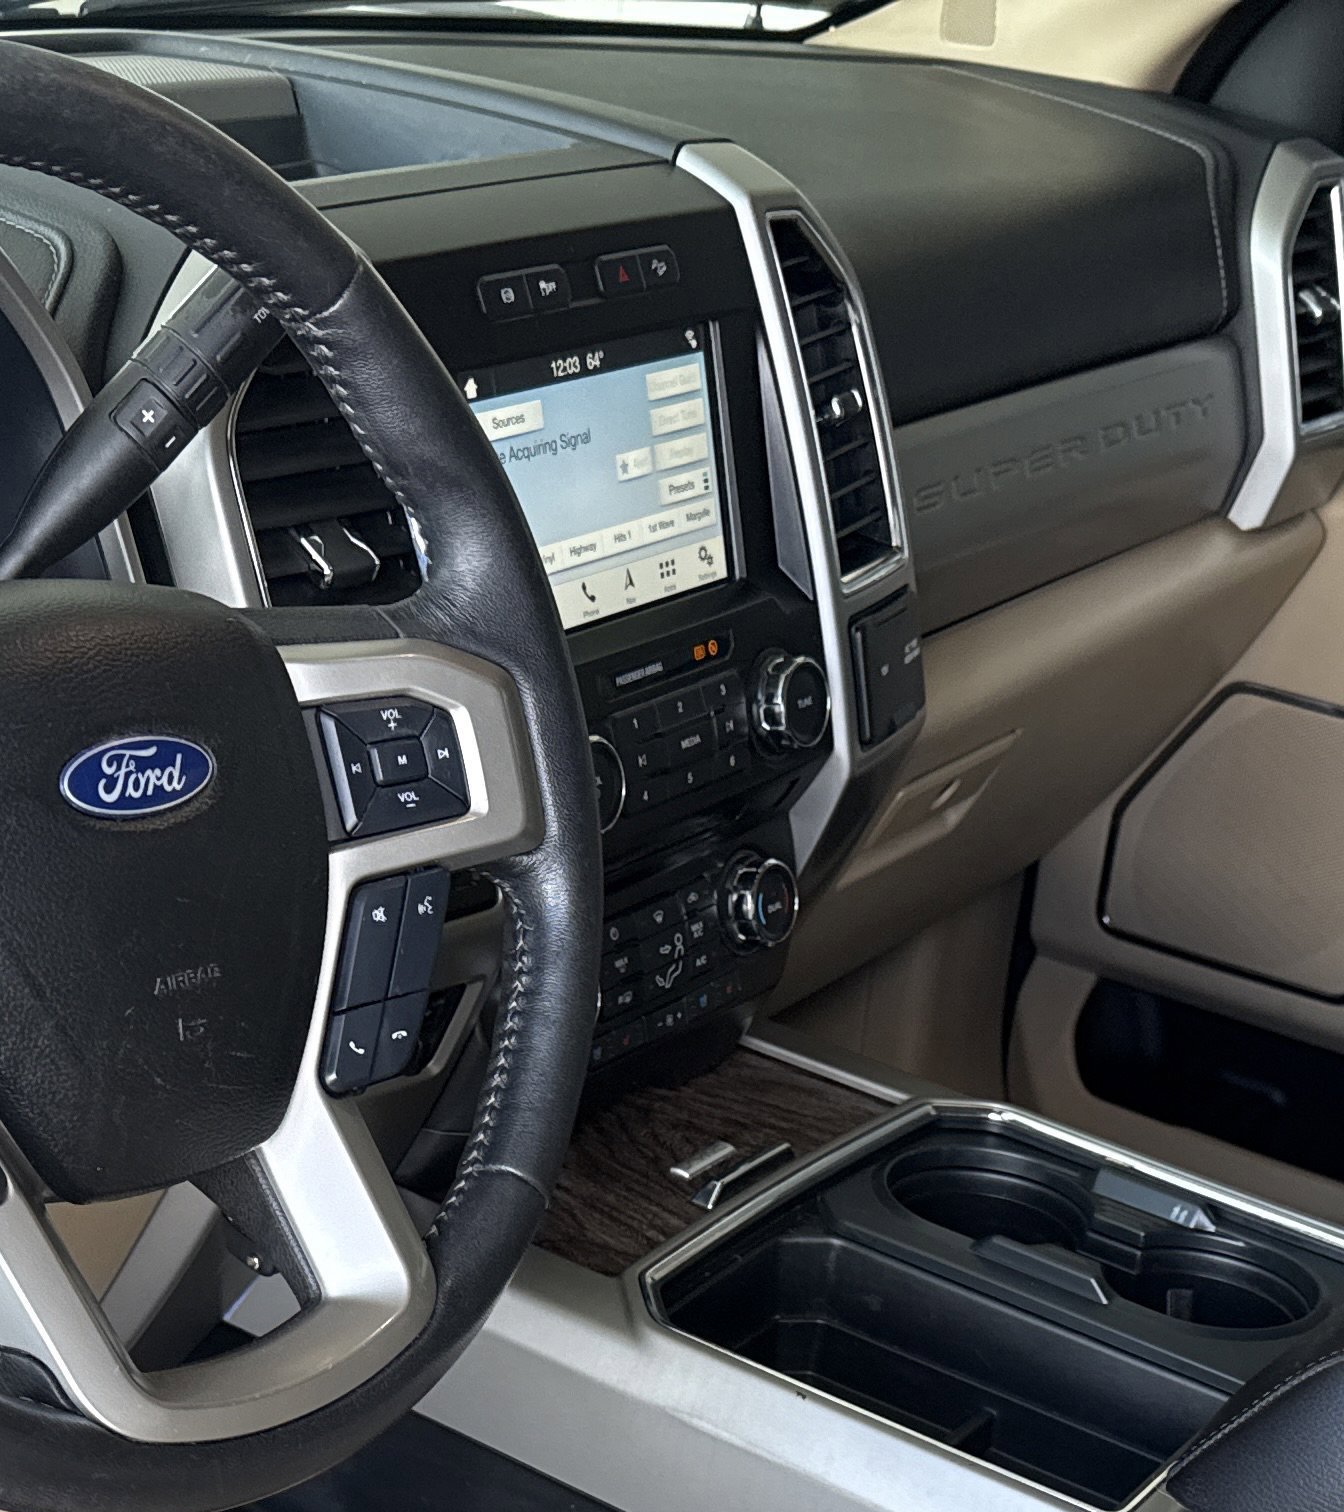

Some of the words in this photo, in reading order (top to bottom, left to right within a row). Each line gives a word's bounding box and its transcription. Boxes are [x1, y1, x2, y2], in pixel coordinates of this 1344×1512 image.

[551, 356, 581, 377] 12:03
[492, 414, 526, 430] Sources
[509, 440, 557, 463] Acquiring
[560, 427, 592, 450] Signal
[913, 435, 1092, 514] SUPER
[1098, 394, 1214, 450] DUTY
[379, 708, 403, 721] VOL
[397, 755, 408, 766] M
[98, 745, 187, 804] Ford
[397, 791, 420, 803] VOL
